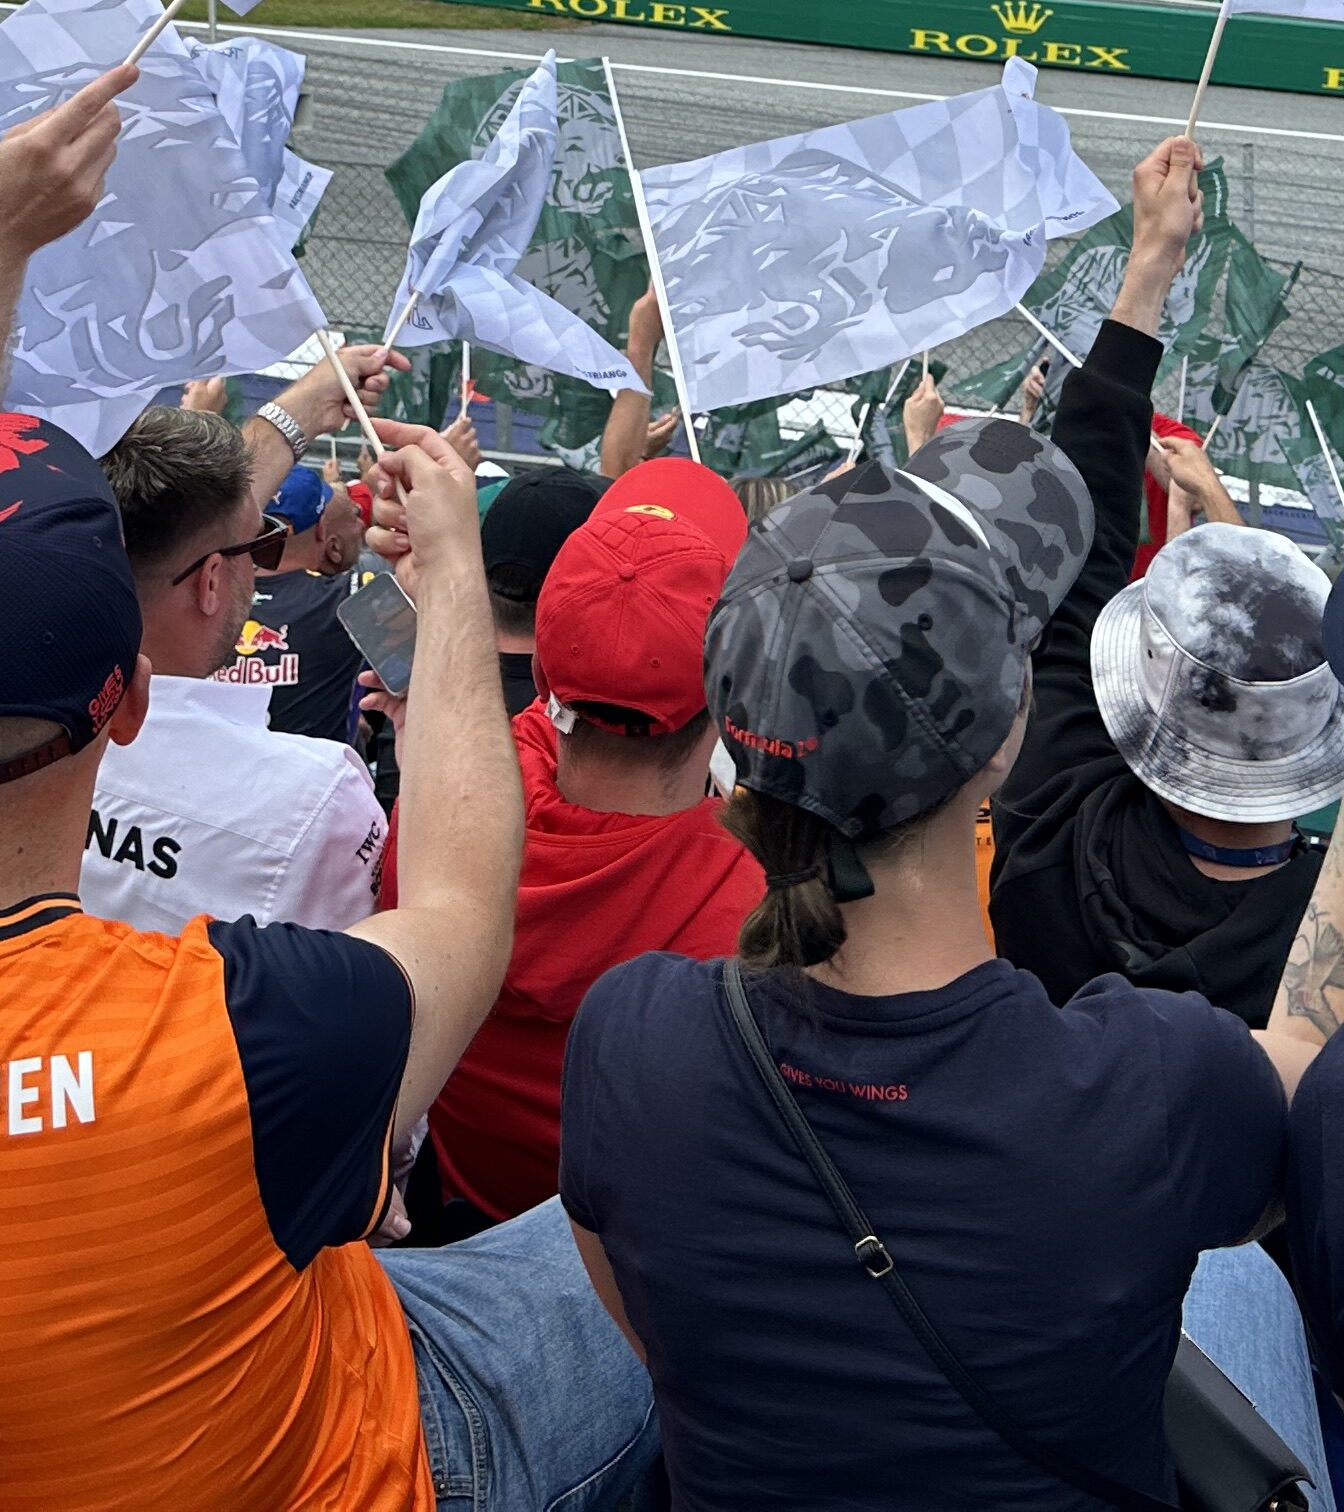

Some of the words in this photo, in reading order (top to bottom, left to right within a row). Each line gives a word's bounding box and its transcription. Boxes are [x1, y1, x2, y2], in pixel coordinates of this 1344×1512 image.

[908, 28, 1131, 70] ROLEX
[246, 653, 299, 686] Bull
[725, 714, 793, 759] Formula
[355, 820, 381, 865] IWC
[780, 1063, 812, 1087] GIVES
[813, 1076, 846, 1094] YOU
[849, 1084, 909, 1101] WINGS
